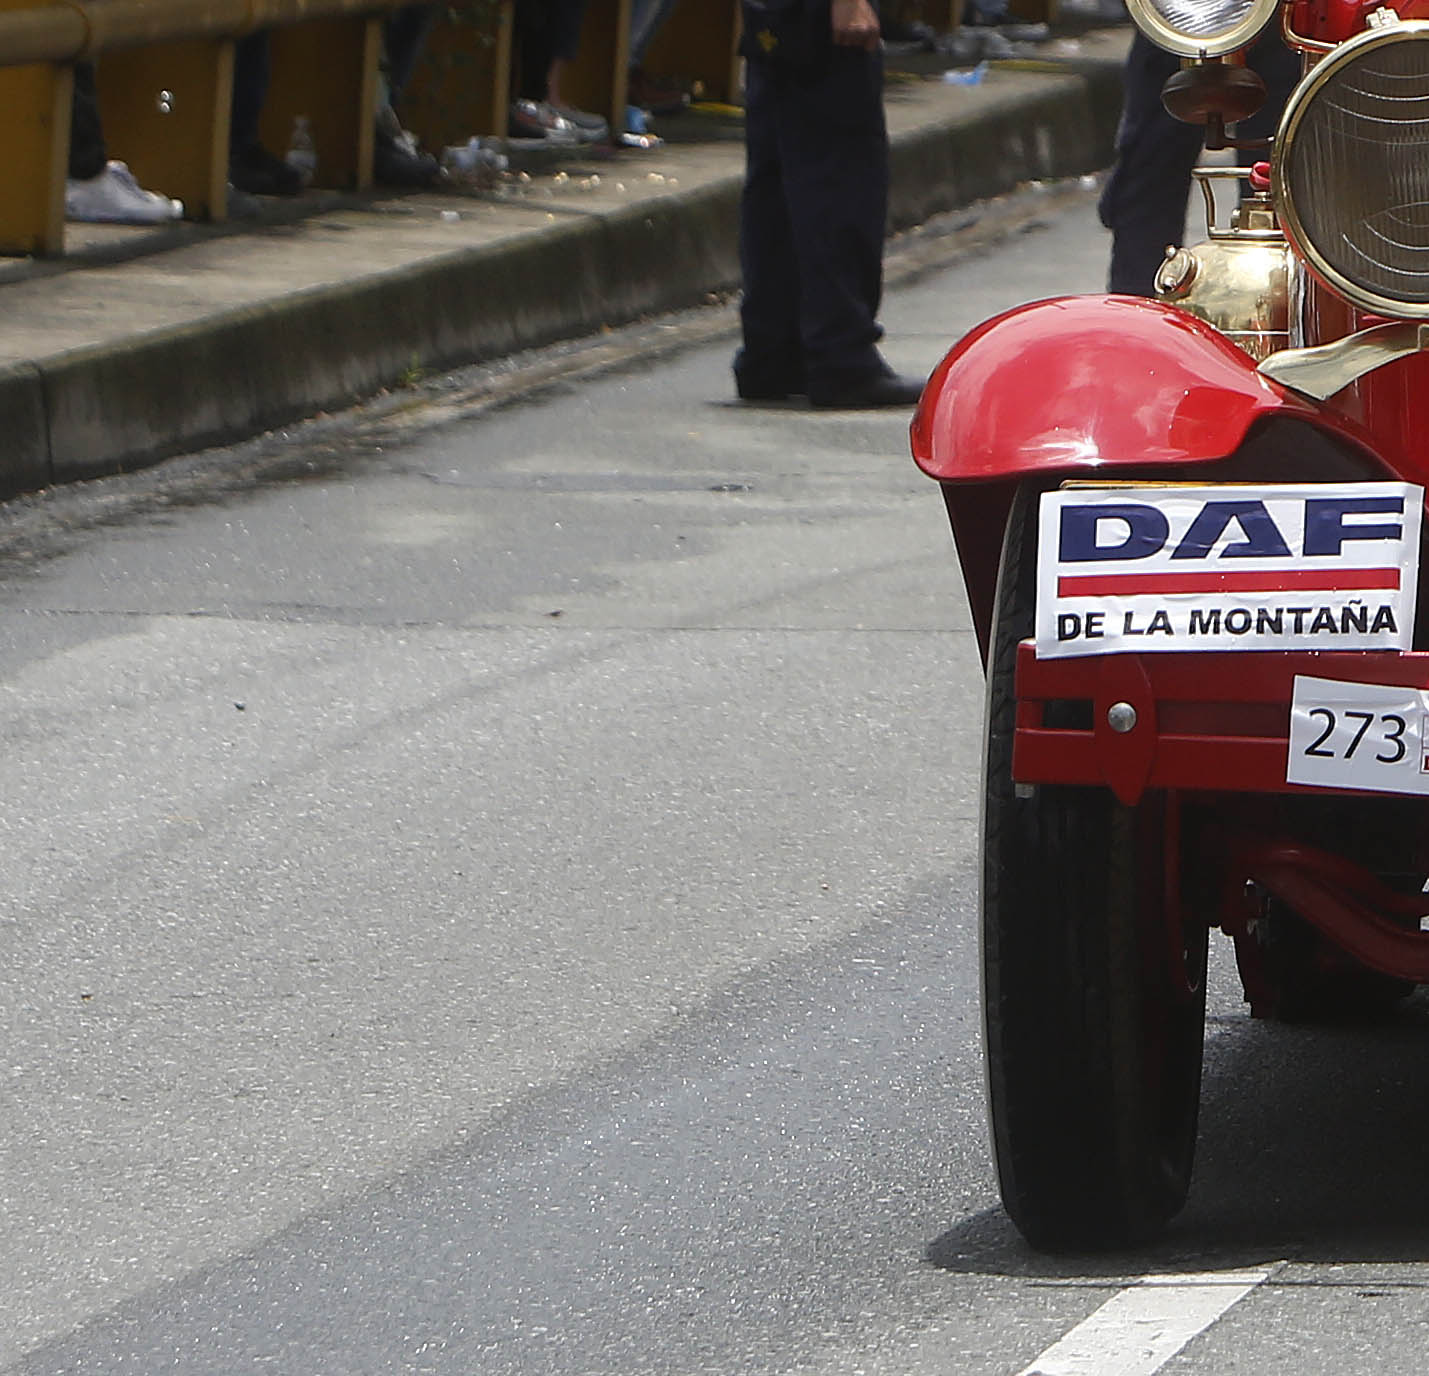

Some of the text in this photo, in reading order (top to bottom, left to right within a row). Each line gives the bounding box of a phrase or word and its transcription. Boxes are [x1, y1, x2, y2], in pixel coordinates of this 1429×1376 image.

[1058, 496, 1404, 562] DAF
[1057, 599, 1397, 641] DE LA MONTAÑA
[1304, 708, 1407, 764] 273
